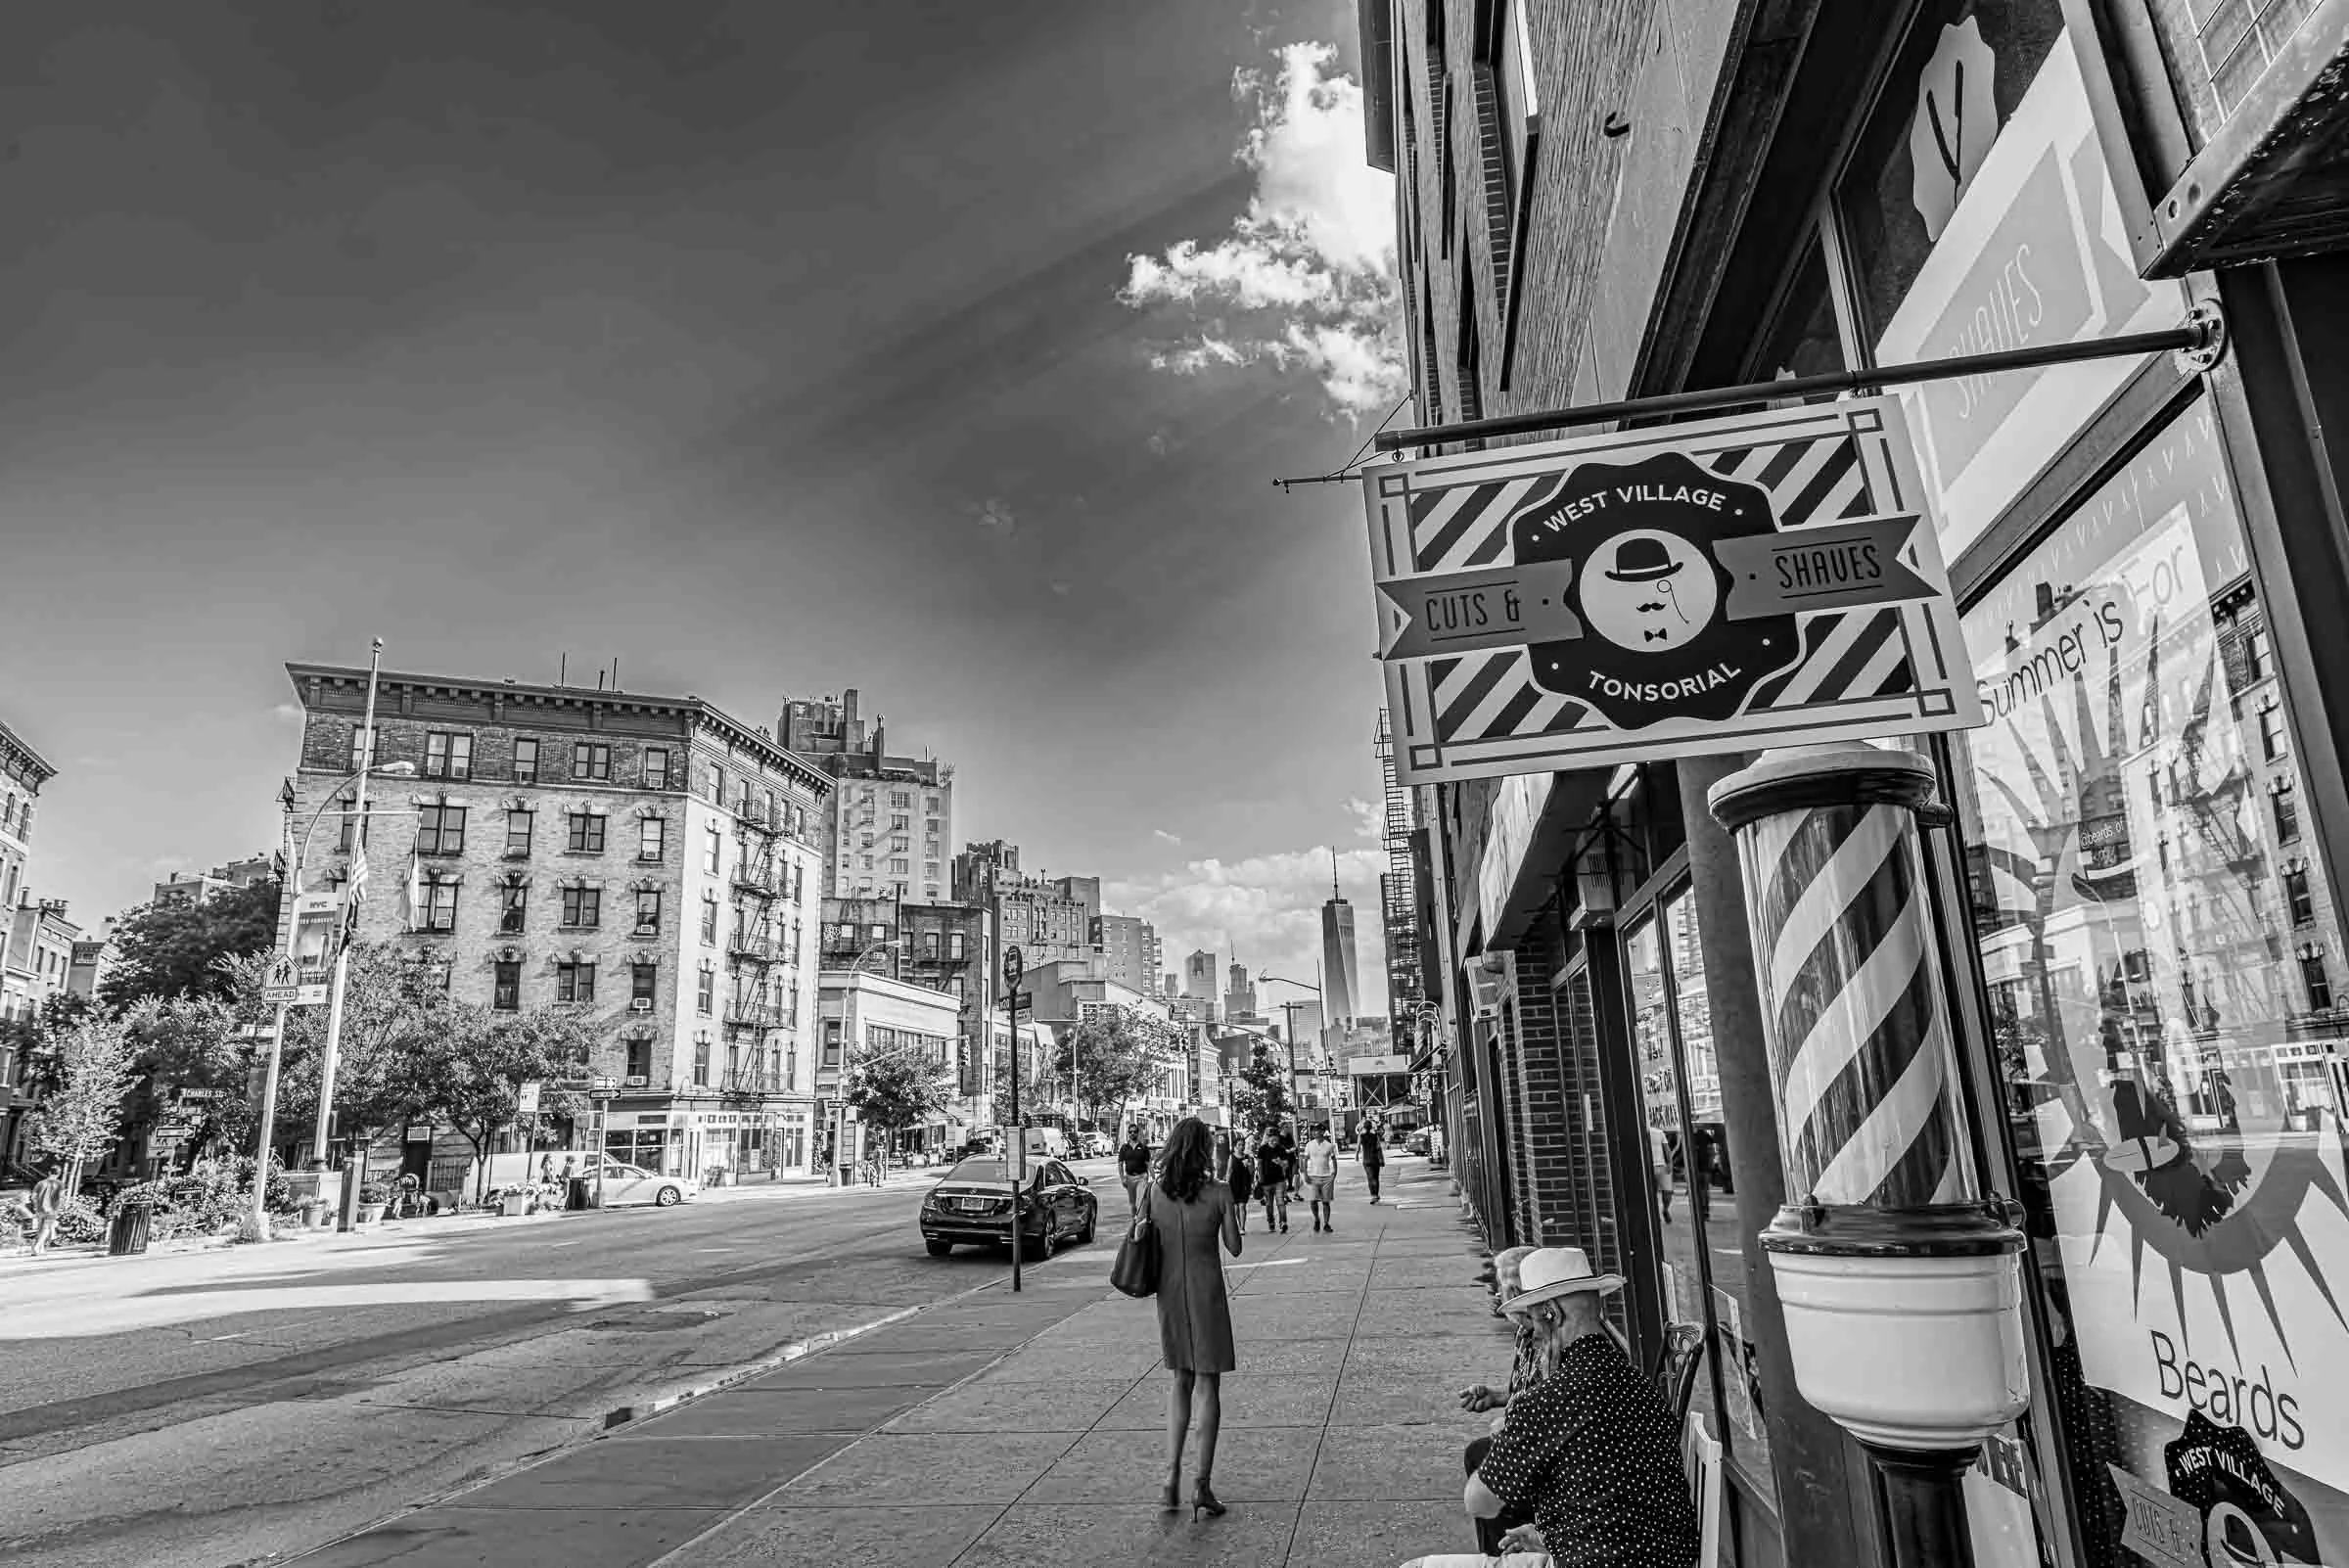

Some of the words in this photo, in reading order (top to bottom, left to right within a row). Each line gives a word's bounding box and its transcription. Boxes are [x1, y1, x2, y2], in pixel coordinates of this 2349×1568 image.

[1543, 490, 1608, 532] WEST
[1616, 484, 1727, 512] VILLAGE
[1774, 544, 1881, 589] SHAVES
[1425, 592, 1489, 631] CUTS
[1504, 588, 1522, 623] &
[1976, 622, 2087, 727] Summer
[2082, 599, 2124, 649] is
[2117, 543, 2185, 607] For
[1588, 661, 1742, 703] TONSORIAL
[309, 900, 328, 909] NYC
[265, 990, 295, 999] AHEAD
[2149, 1328, 2306, 1451] Beards
[2178, 1445, 2213, 1476] WEST
[2216, 1453, 2286, 1519] VILLAGE
[2132, 1497, 2166, 1544] CUTS
